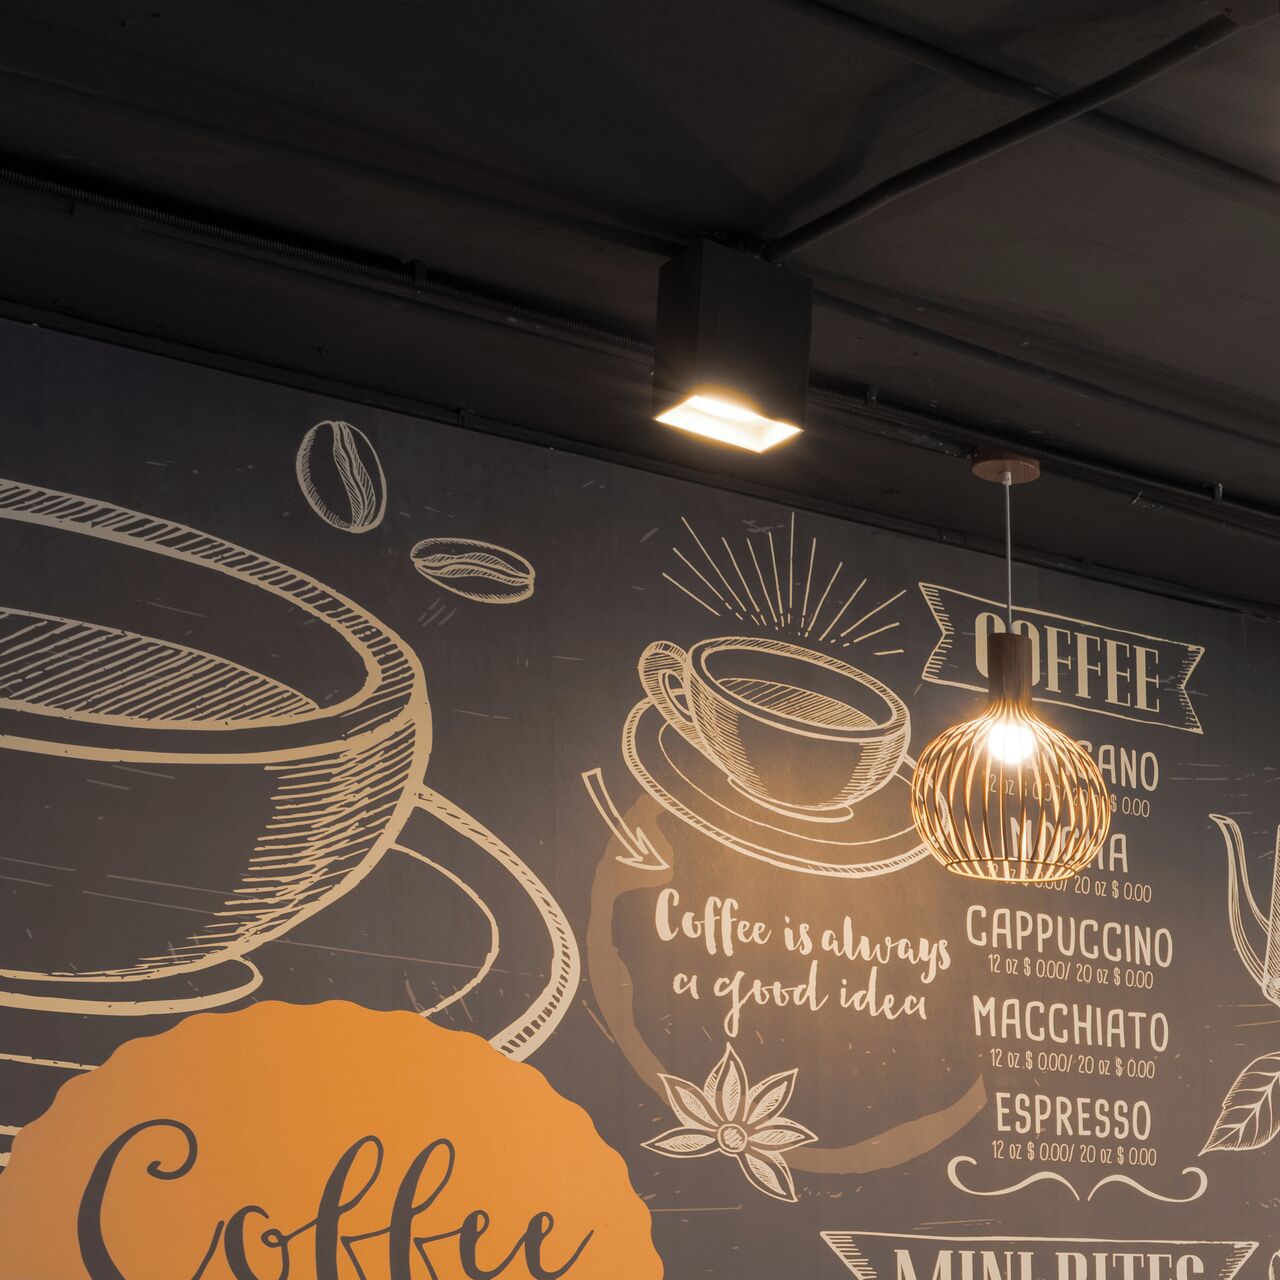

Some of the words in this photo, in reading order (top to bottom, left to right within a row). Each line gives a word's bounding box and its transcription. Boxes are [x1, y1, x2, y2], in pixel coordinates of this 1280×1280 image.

[1111, 794, 1117, 812] $
[1122, 797, 1150, 817] 0.00
[1075, 875, 1090, 894] 20
[1095, 882, 1107, 896] oz
[1112, 880, 1118, 899] $
[1124, 882, 1151, 902] 0.00
[656, 888, 772, 956] Coffee
[784, 916, 812, 955] is
[821, 916, 950, 984] always
[966, 905, 1173, 968] CAPPUCCINO
[988, 954, 1000, 972] 12
[1006, 959, 1018, 974] oz
[1024, 957, 1030, 977] $
[1036, 960, 1071, 980] 0.00/
[1077, 964, 1092, 982] 20
[1097, 969, 1108, 984] oz
[1114, 967, 1120, 986] $
[1126, 969, 1153, 989] 0.00
[673, 973, 699, 1000] a
[714, 960, 828, 1038] good
[840, 966, 926, 1020] idea
[972, 995, 1168, 1052] MACCHIATO
[990, 1049, 1002, 1067] 12
[1008, 1054, 1020, 1068] oz
[1026, 1051, 1032, 1069] $
[1038, 1052, 1073, 1072] 0.00/
[1079, 1056, 1094, 1074] 20
[1099, 1060, 1110, 1075] oz
[1115, 1058, 1122, 1077] $
[1128, 1059, 1155, 1078] 0.00
[996, 1092, 1151, 1140] ESPRESSO
[992, 1140, 1004, 1158] 12
[1009, 1144, 1021, 1159] oz
[1027, 1141, 1034, 1161] $
[1040, 1143, 1074, 1162] 0.00/
[1080, 1145, 1096, 1163] 20
[1101, 1149, 1112, 1164] oz
[1117, 1146, 1124, 1165] $
[1129, 1148, 1156, 1166] 0.00
